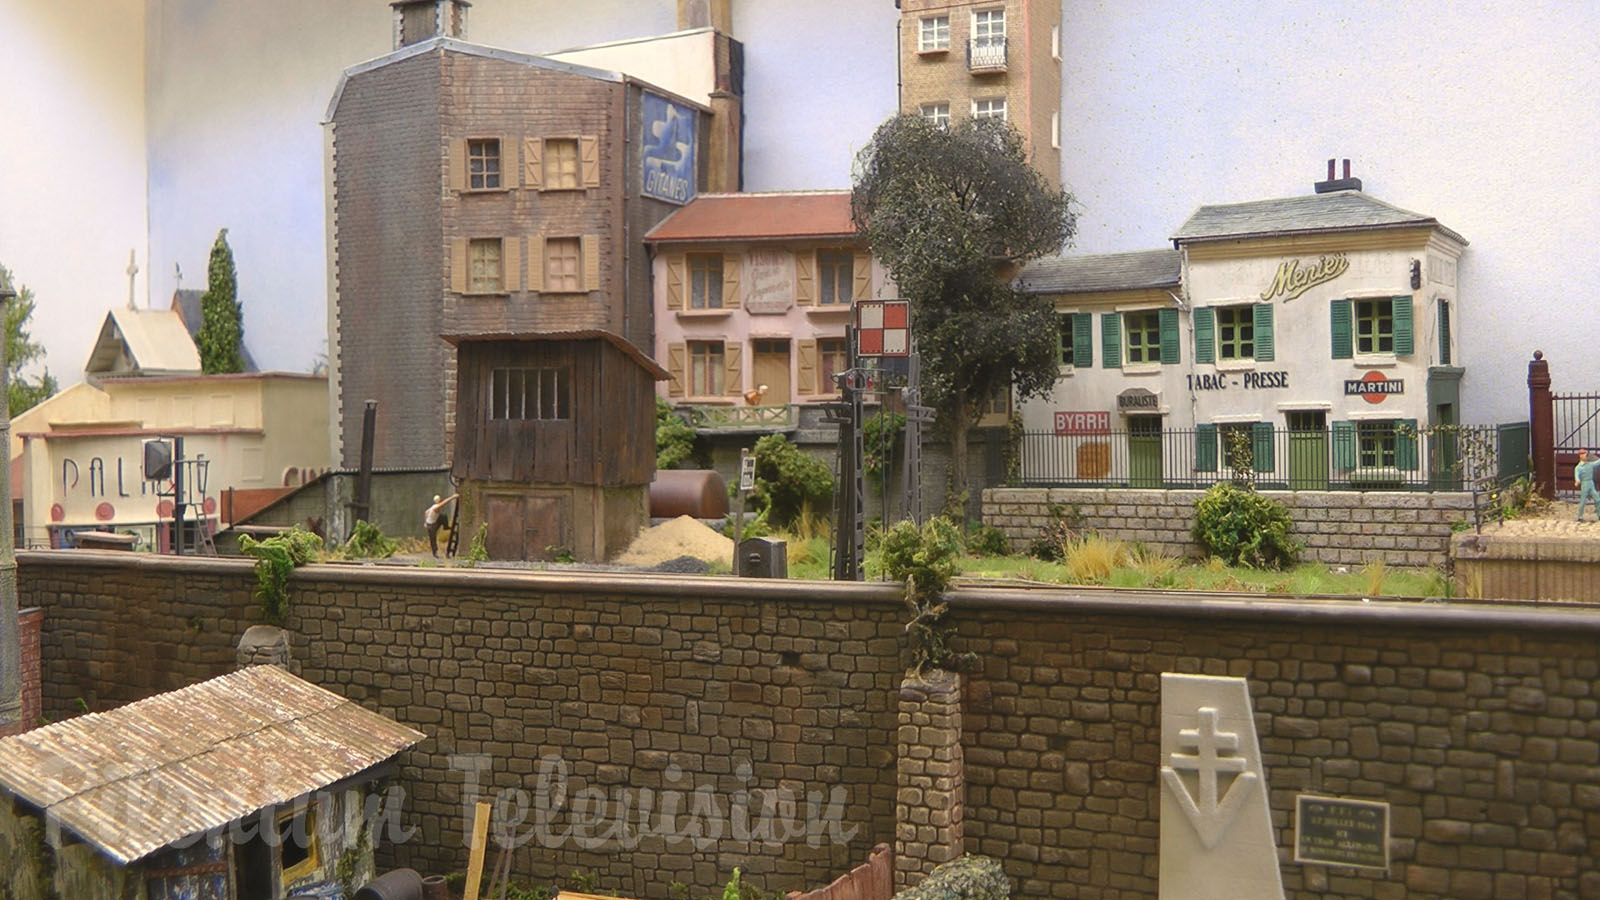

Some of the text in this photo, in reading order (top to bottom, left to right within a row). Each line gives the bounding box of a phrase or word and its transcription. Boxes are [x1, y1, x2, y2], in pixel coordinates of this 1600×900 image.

[646, 169, 689, 201] GITANES
[1260, 252, 1350, 302] Menier
[1186, 373, 1227, 391] TABAC
[1243, 371, 1290, 389] PRESSE
[1346, 381, 1403, 394] MARTINI
[1055, 413, 1109, 431] BYRRH
[62, 453, 206, 498] PALE
